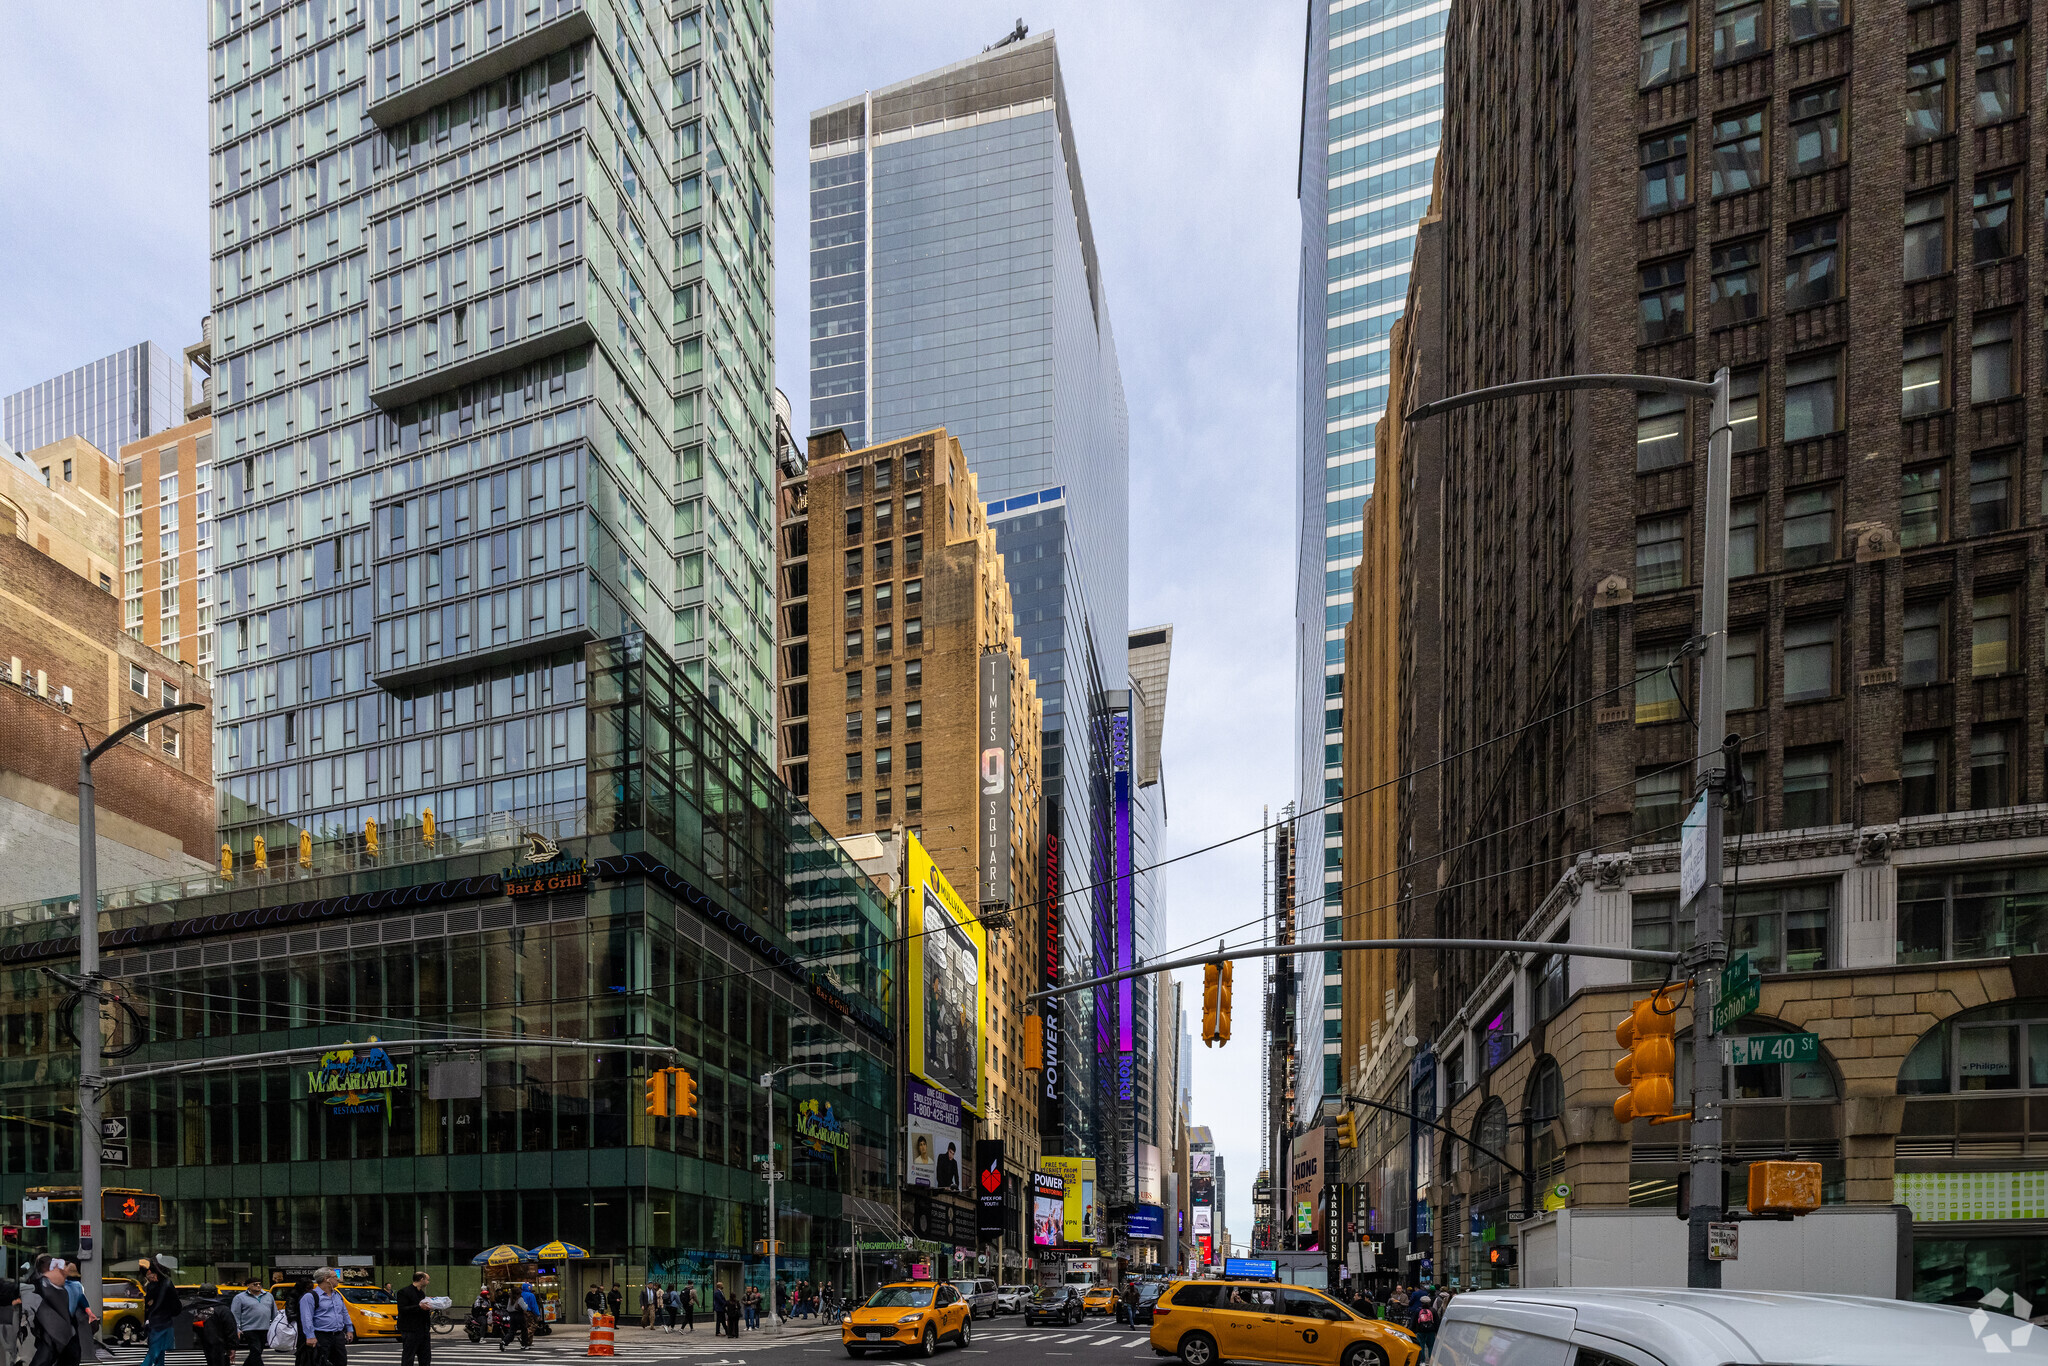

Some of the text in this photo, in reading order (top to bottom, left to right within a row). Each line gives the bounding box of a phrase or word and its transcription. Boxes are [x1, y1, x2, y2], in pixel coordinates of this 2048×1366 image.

[982, 661, 1005, 897] TIMES 9 SQUARE
[502, 857, 582, 881] LANDSHARK
[506, 874, 582, 896] Bar & Grill
[940, 883, 964, 920] MULLVAD
[1047, 833, 1059, 979] MENTORING
[1727, 965, 1741, 992] 7 Av
[1715, 985, 1756, 1029] Fashion Av
[1047, 1014, 1058, 1100] POWER
[1749, 1037, 1813, 1061] W 40 St
[308, 1064, 408, 1094] MARGARITAVILLE
[913, 1092, 959, 1115] ENDLESS POSSIBILITIES
[926, 1087, 935, 1097] ONE
[333, 1104, 380, 1116] RESTAURANT
[913, 1102, 960, 1126] 1-800-425-HELP
[103, 1123, 120, 1133] WAY
[102, 1150, 118, 1159] AY
[1295, 1157, 1317, 1180] KONG
[1034, 1173, 1063, 1190] POWER
[1140, 1191, 1153, 1200] UBS
[1306, 1331, 1315, 1342] T
